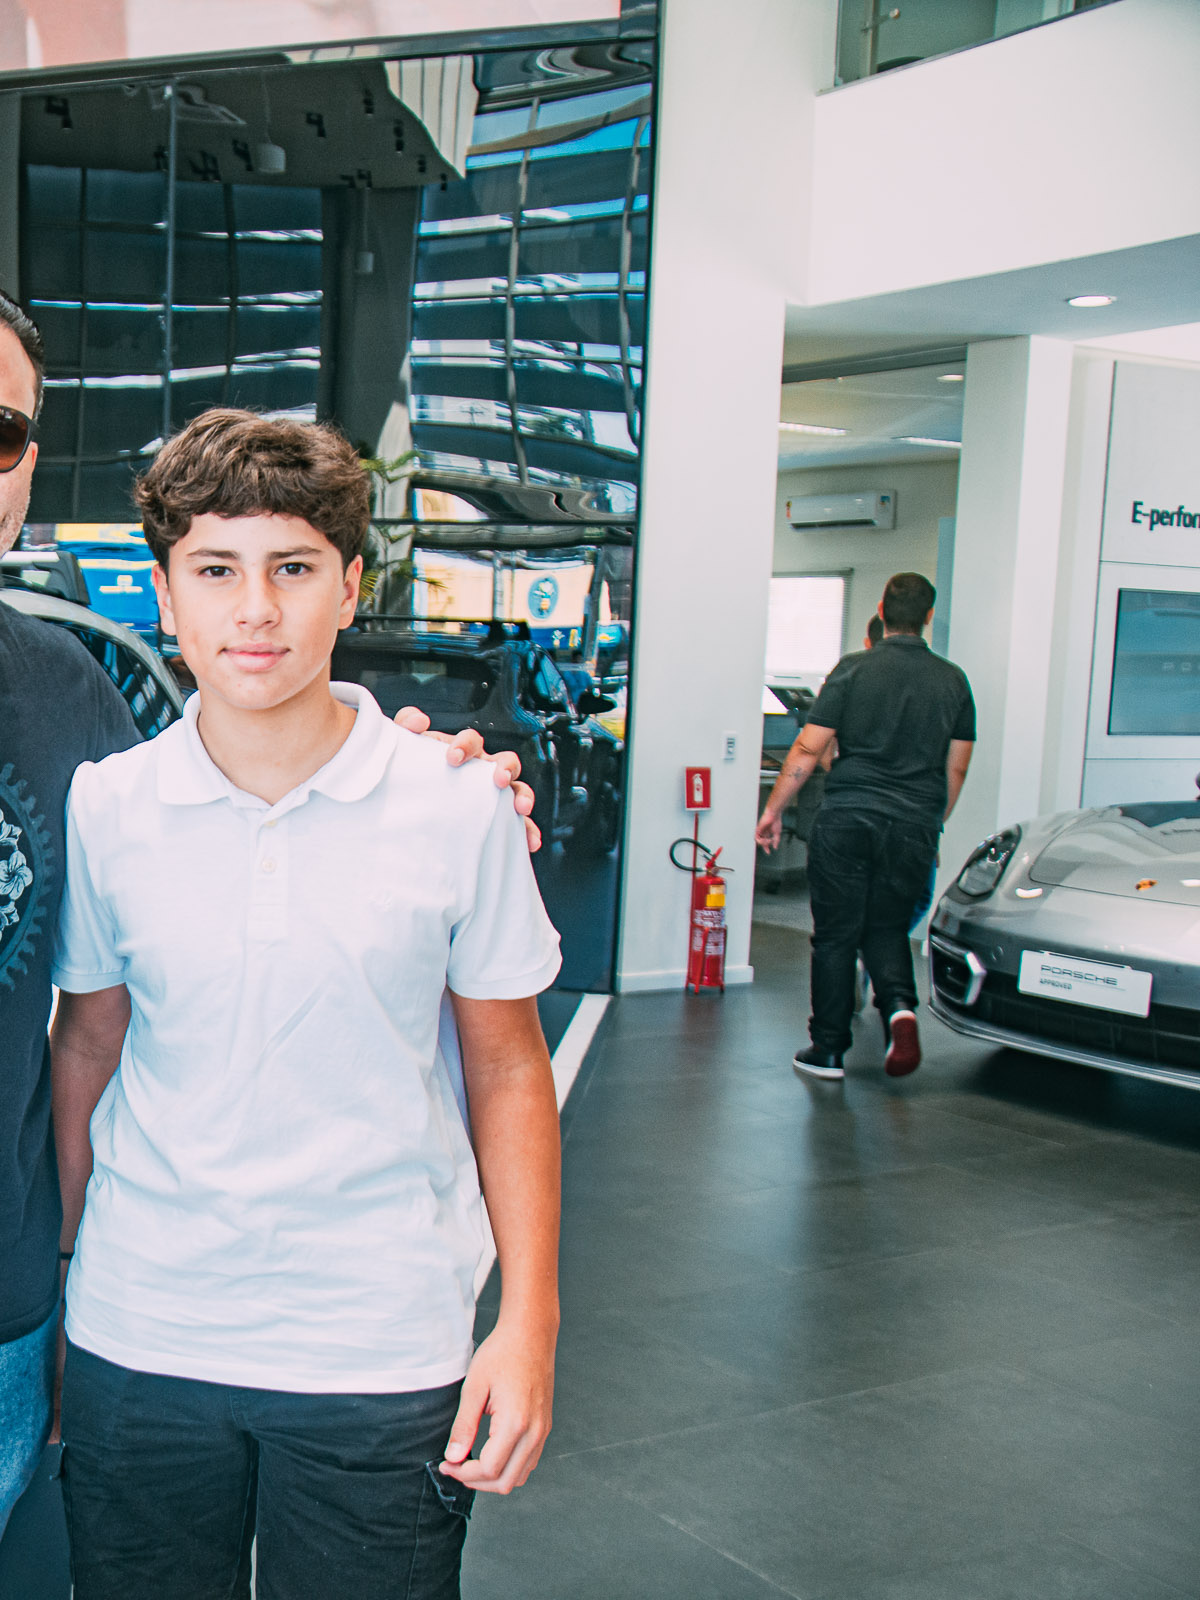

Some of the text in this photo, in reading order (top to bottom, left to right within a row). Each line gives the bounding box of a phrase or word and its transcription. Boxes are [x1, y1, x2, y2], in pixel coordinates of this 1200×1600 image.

[1131, 500, 1200, 531] E-perfor
[1040, 978, 1072, 990] APPROVED
[1041, 965, 1117, 985] PORSCHE
